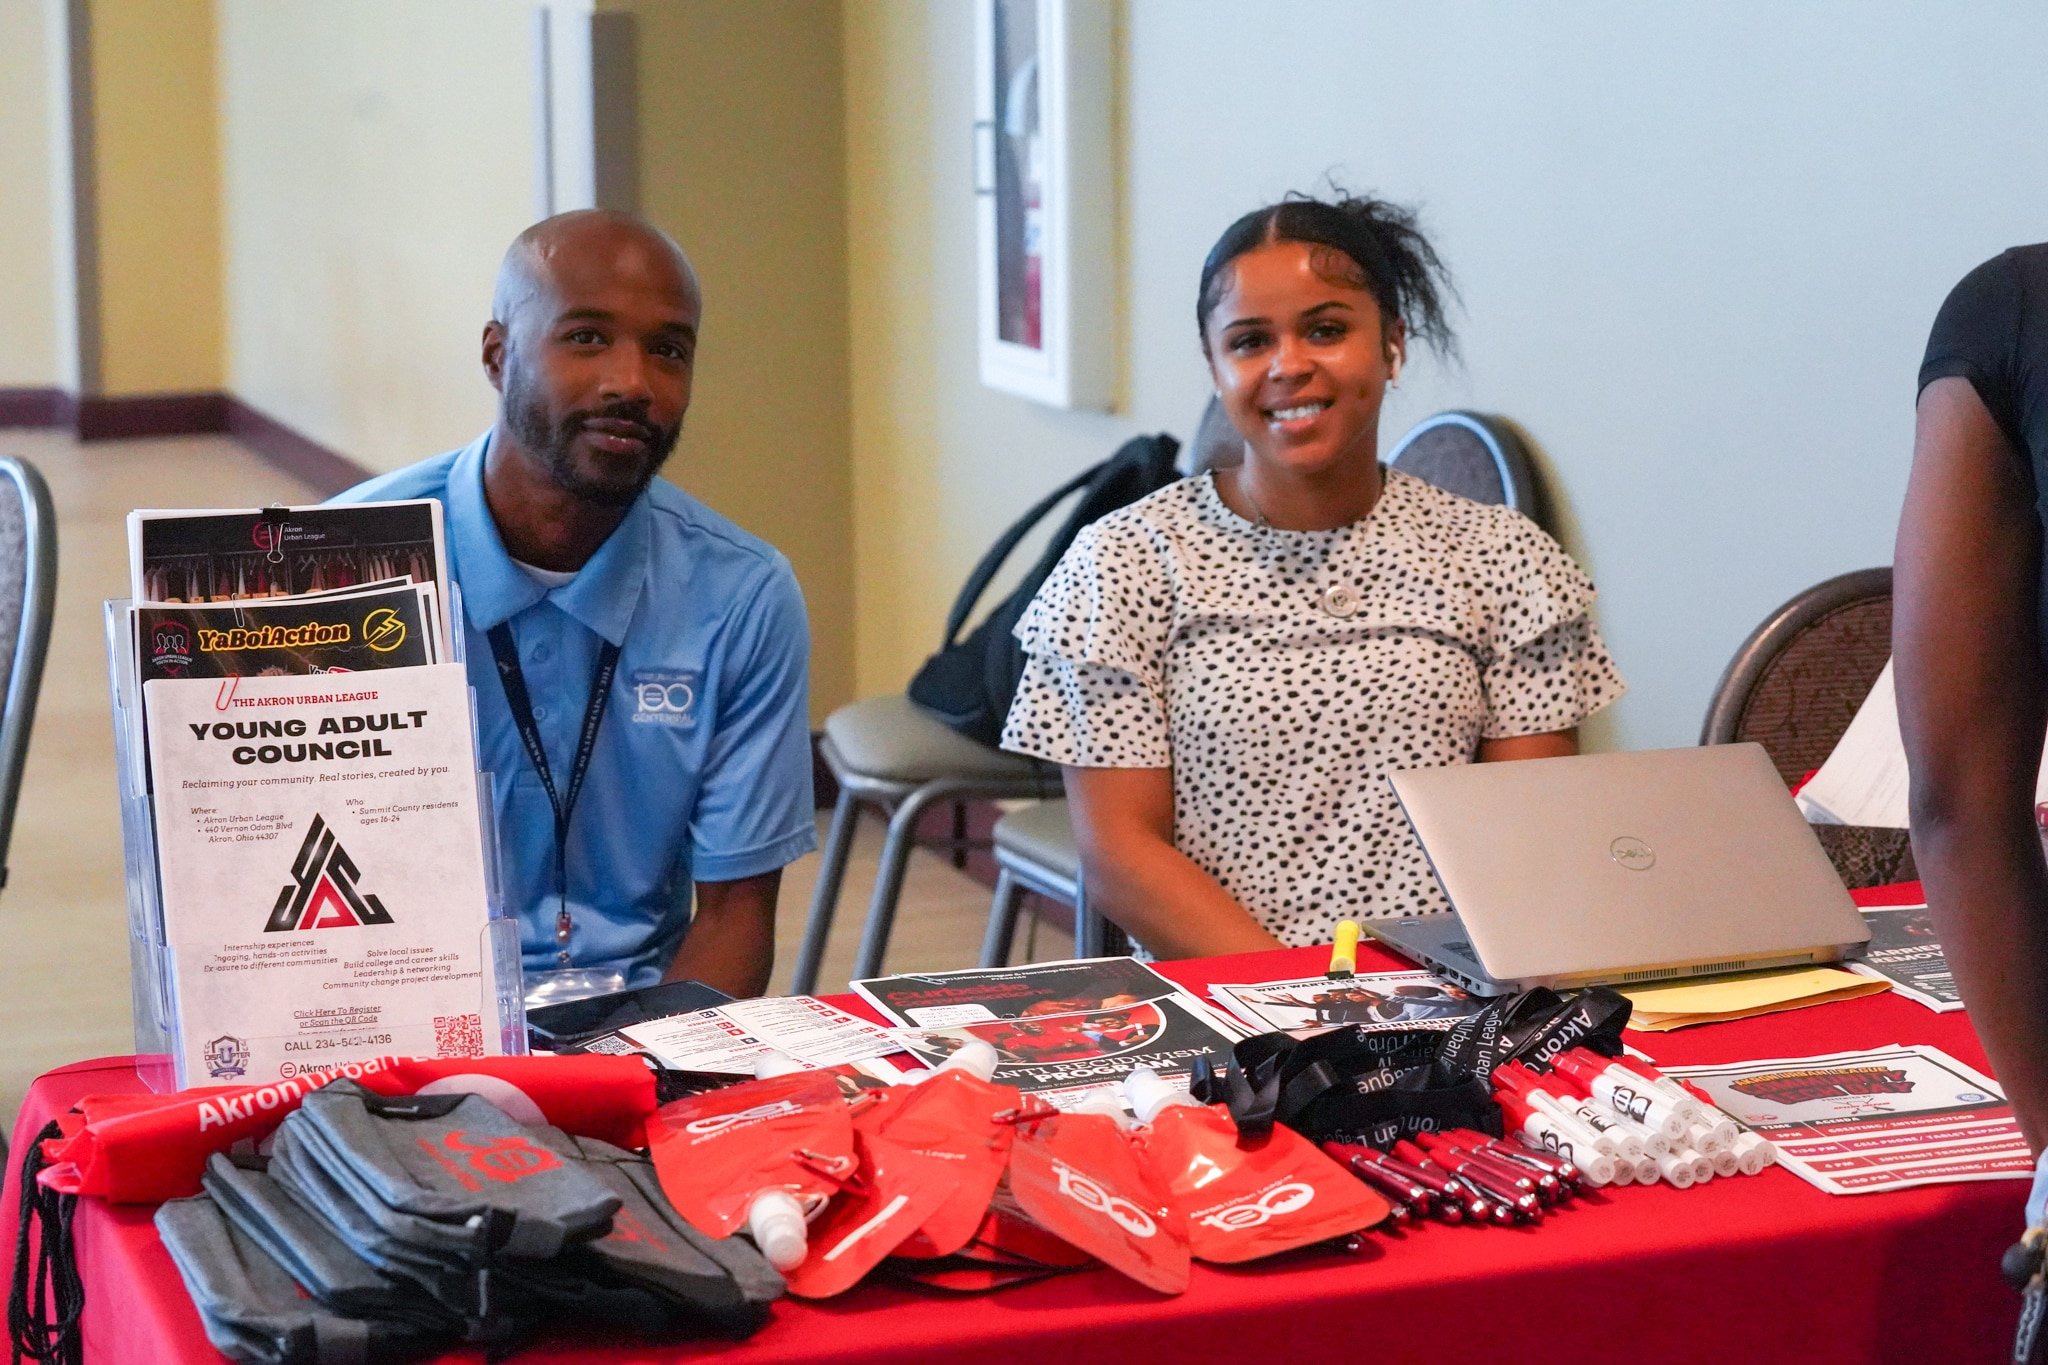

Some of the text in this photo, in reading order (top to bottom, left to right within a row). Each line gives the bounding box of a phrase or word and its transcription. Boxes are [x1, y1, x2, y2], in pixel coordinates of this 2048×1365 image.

[198, 622, 350, 651] YaBoiAction
[233, 691, 378, 707] THE AKRON URBAN LEAGUE
[189, 710, 428, 741] YOUNG ADULT
[232, 739, 392, 765] COUNCIL
[182, 779, 235, 789] Reclaiming
[236, 779, 258, 788] your
[319, 773, 340, 782] Real
[342, 771, 377, 780] stories,
[378, 767, 415, 778] created
[417, 766, 429, 776] by
[359, 802, 459, 815] Summit County residents
[204, 816, 228, 824] Akron
[255, 814, 284, 823] League
[380, 815, 400, 823] 16-24
[220, 825, 249, 833] Vernon
[250, 823, 274, 831] Odom
[276, 822, 293, 830] Blvd
[236, 834, 255, 842] Ohio
[224, 940, 315, 952] Internship experiences
[367, 949, 388, 957] Solve
[410, 946, 434, 954] issues
[253, 951, 290, 959] hands-on
[291, 947, 328, 956] activities
[1869, 951, 1944, 963] REMOV
[240, 962, 249, 970] to
[250, 959, 285, 970] different
[286, 957, 338, 967] communities
[343, 952, 460, 969] Build college and career skills
[354, 966, 398, 978] Leadership
[406, 963, 452, 974] networking
[323, 971, 482, 990] Community change project development
[294, 1005, 382, 1019] Click Here To Register
[310, 1018, 331, 1027] Scan
[331, 1016, 343, 1025] the
[344, 1015, 357, 1025] QR
[358, 1014, 378, 1023] Code
[1535, 1008, 1593, 1063] Akron
[285, 1041, 312, 1051] CALL
[1471, 1008, 1502, 1081] rban League
[1058, 1046, 1215, 1076] RECIDIVISM
[1036, 1058, 1179, 1083] PROGRAM
[199, 1078, 303, 1133] Akron
[1815, 1117, 1861, 1126] AGENDA
[1890, 1114, 1975, 1127] INTRODUCTION
[1926, 1131, 1965, 1140] TABLET
